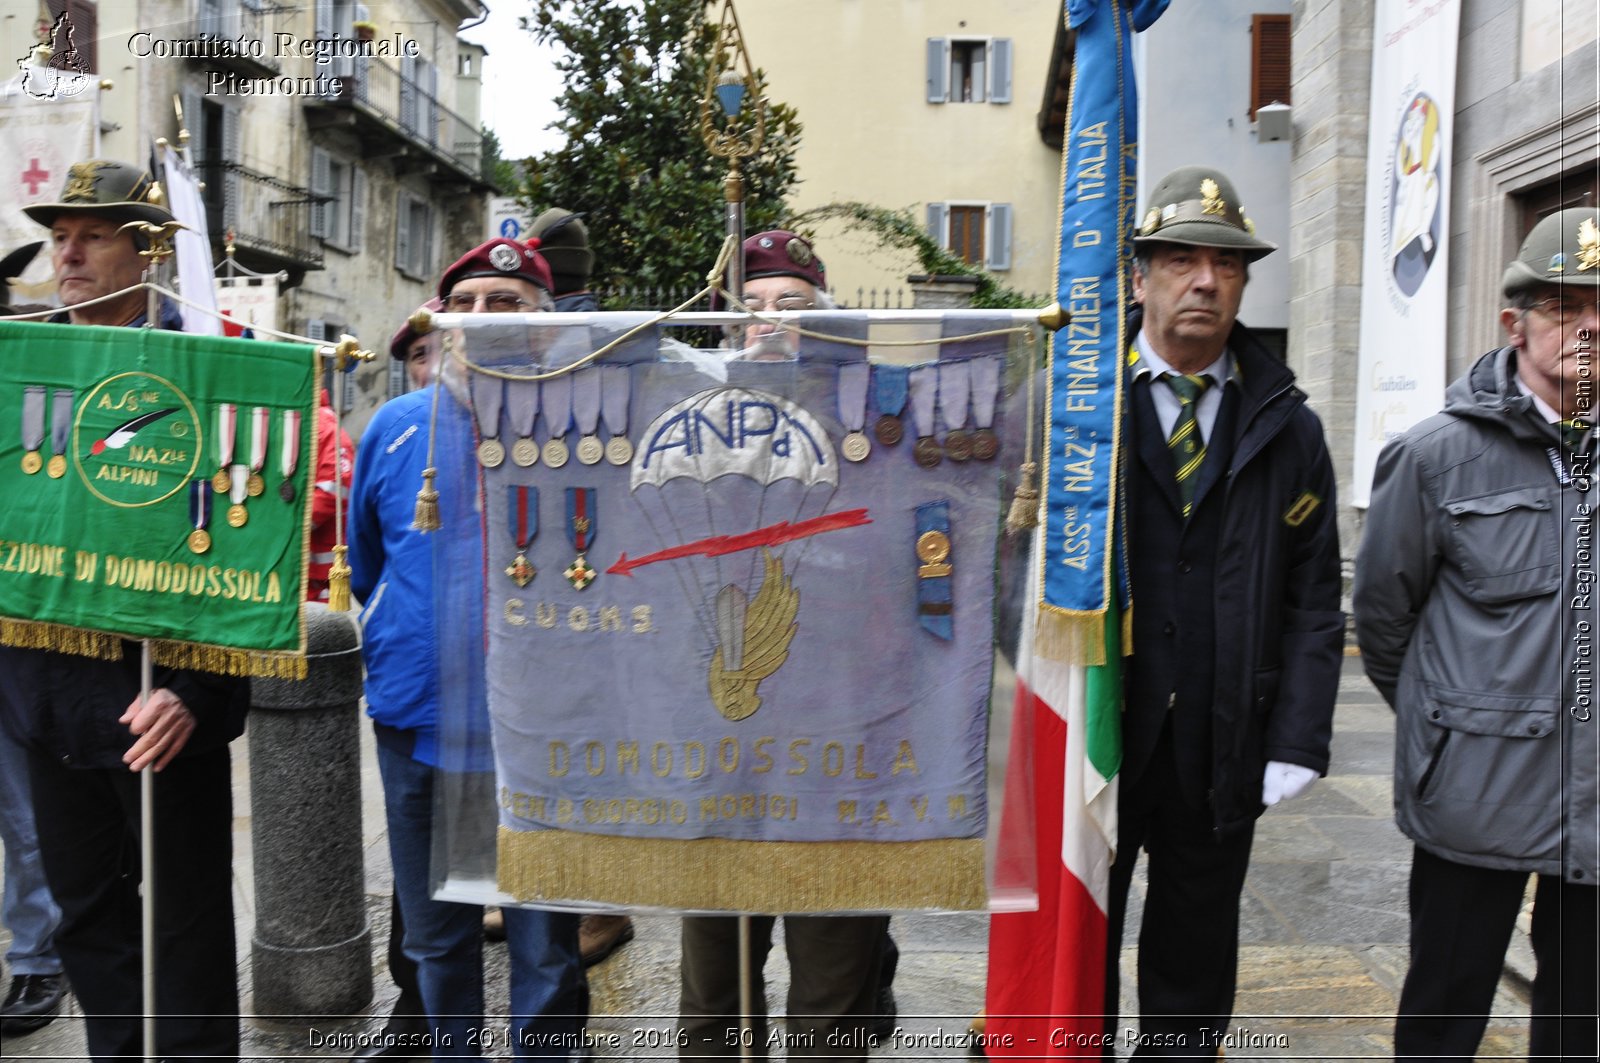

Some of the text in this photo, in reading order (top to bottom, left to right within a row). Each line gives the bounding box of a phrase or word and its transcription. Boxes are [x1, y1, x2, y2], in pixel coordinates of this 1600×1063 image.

[1077, 120, 1109, 203] ITALIA
[1065, 276, 1101, 412] FINANZIERI
[96, 464, 159, 486] ALPINI
[75, 550, 97, 583] DI
[104, 554, 281, 603] DOMODOSSOLA
[547, 736, 920, 780] DOMODOSSOLA
[582, 798, 688, 826] GIORGIO
[700, 794, 798, 822] MORIGI
